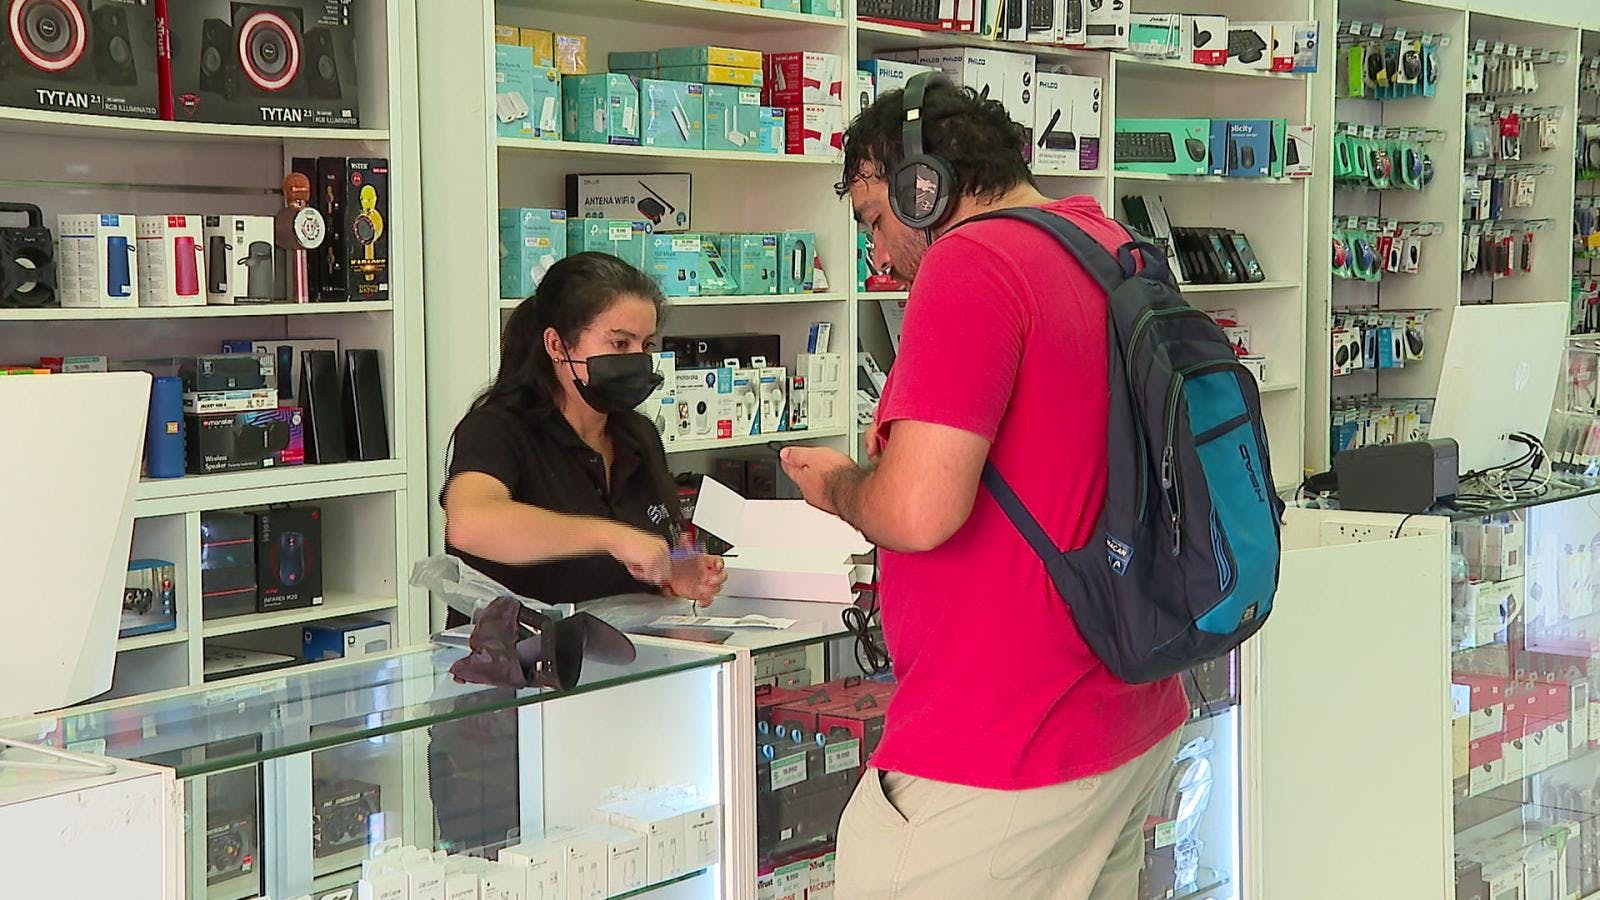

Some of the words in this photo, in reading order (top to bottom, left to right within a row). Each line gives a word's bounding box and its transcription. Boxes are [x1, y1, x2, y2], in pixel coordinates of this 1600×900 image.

[880, 68, 904, 79] PHILCO
[36, 89, 88, 108] TYTAN
[90, 94, 101, 103] 2.1
[260, 107, 302, 122] TYTAN
[303, 109, 312, 117] 2.1
[584, 196, 614, 206] ANTENA
[208, 418, 235, 426] monster
[204, 454, 228, 462] Wireless
[204, 462, 227, 471] Speaker
[1239, 444, 1265, 503] HEAD
